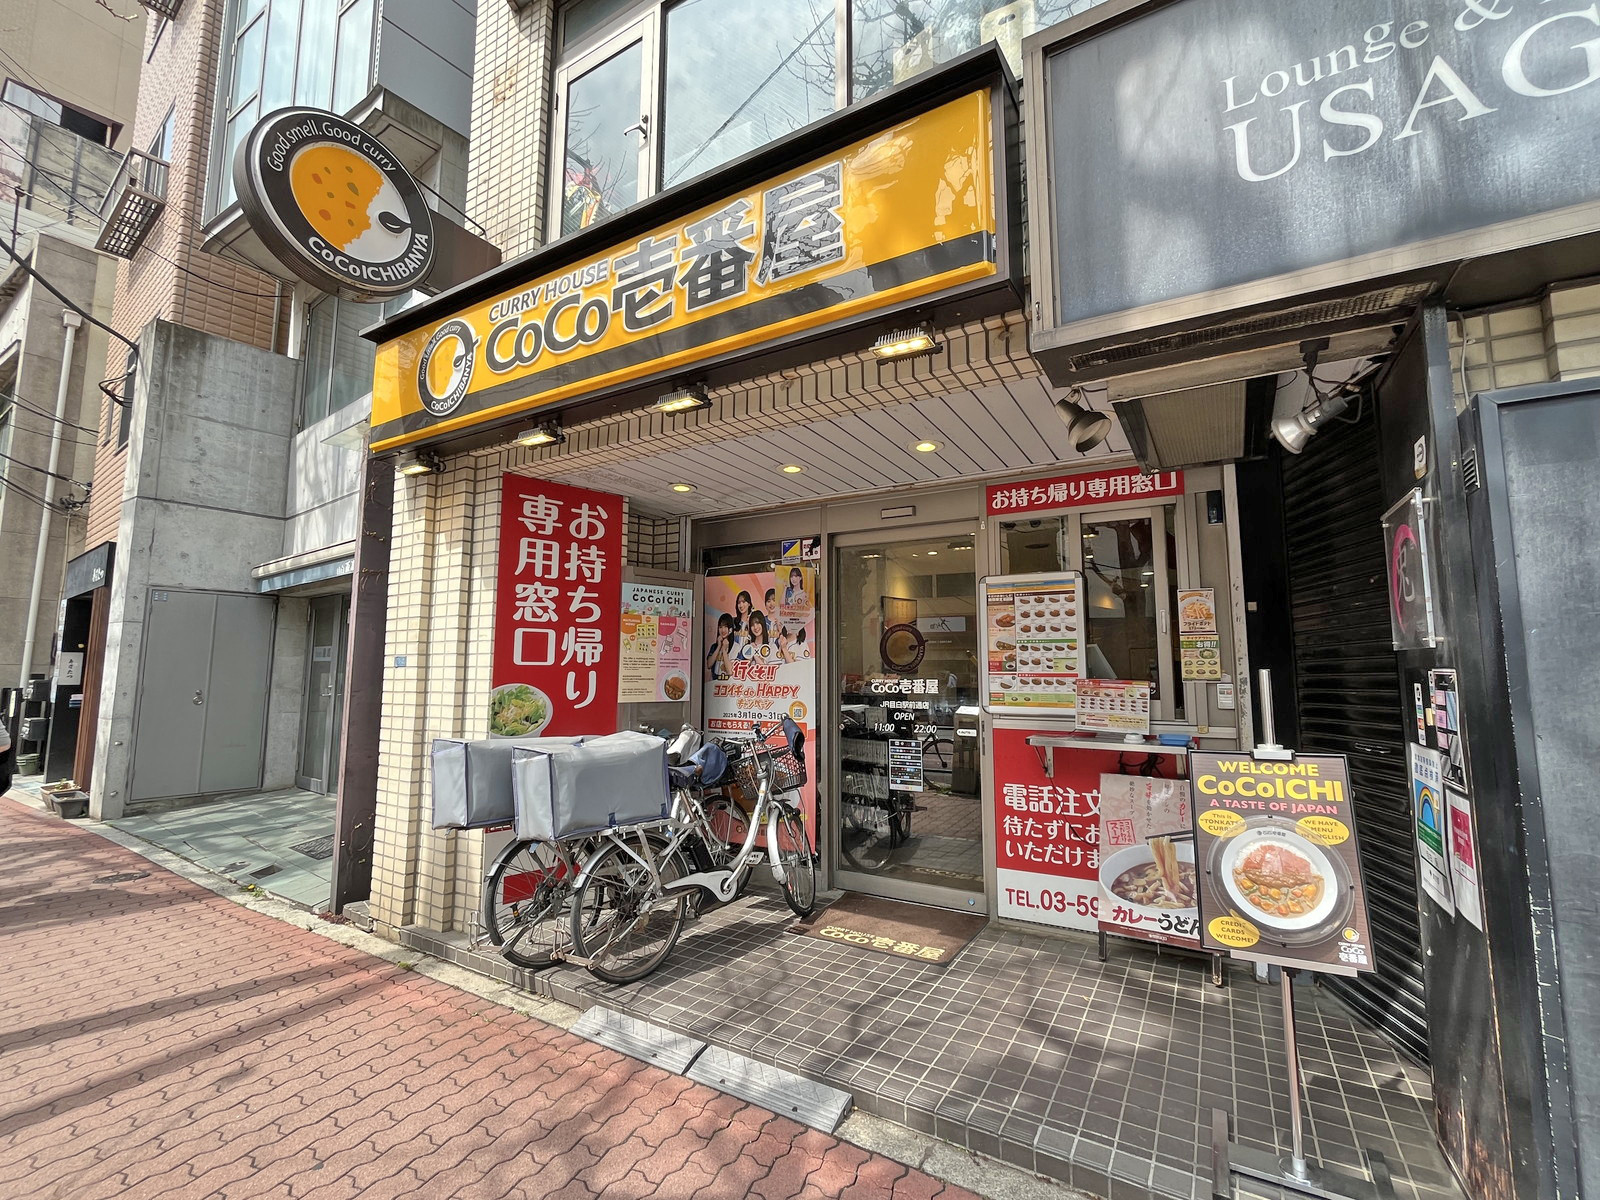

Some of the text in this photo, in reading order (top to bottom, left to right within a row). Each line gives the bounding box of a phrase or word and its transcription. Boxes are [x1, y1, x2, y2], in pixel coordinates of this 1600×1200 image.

[1220, 0, 1513, 113] Lounge &
[267, 119, 397, 172] Good smell. Good curry
[308, 233, 428, 282] CoCoICHIBANYA
[488, 258, 609, 323] CURRY HOUSE
[431, 352, 473, 411] CoCoICHIBANYA
[991, 472, 1177, 510] お持ち帰り専用窓口
[512, 493, 564, 666] 専用窓口
[632, 587, 664, 595] JAPANESE
[560, 502, 608, 709] お持ち帰り
[632, 594, 684, 606] CoCoICHI
[756, 684, 800, 699] HAPPY
[871, 679, 939, 694] CoCo壱番屋
[874, 723, 895, 731] 11:00
[914, 724, 937, 733] 22:00
[894, 712, 915, 720] OPEN
[1217, 760, 1320, 777] WELCOME
[1002, 783, 1101, 818] 電話注文
[1197, 774, 1344, 802] CoCoICHI
[1210, 799, 1338, 815] A TASTE OF JAPAN
[1003, 815, 1099, 846] 待たずにお
[1110, 822, 1121, 844] スープ
[1005, 840, 1099, 870] いただけま
[1221, 926, 1245, 935] CARDS
